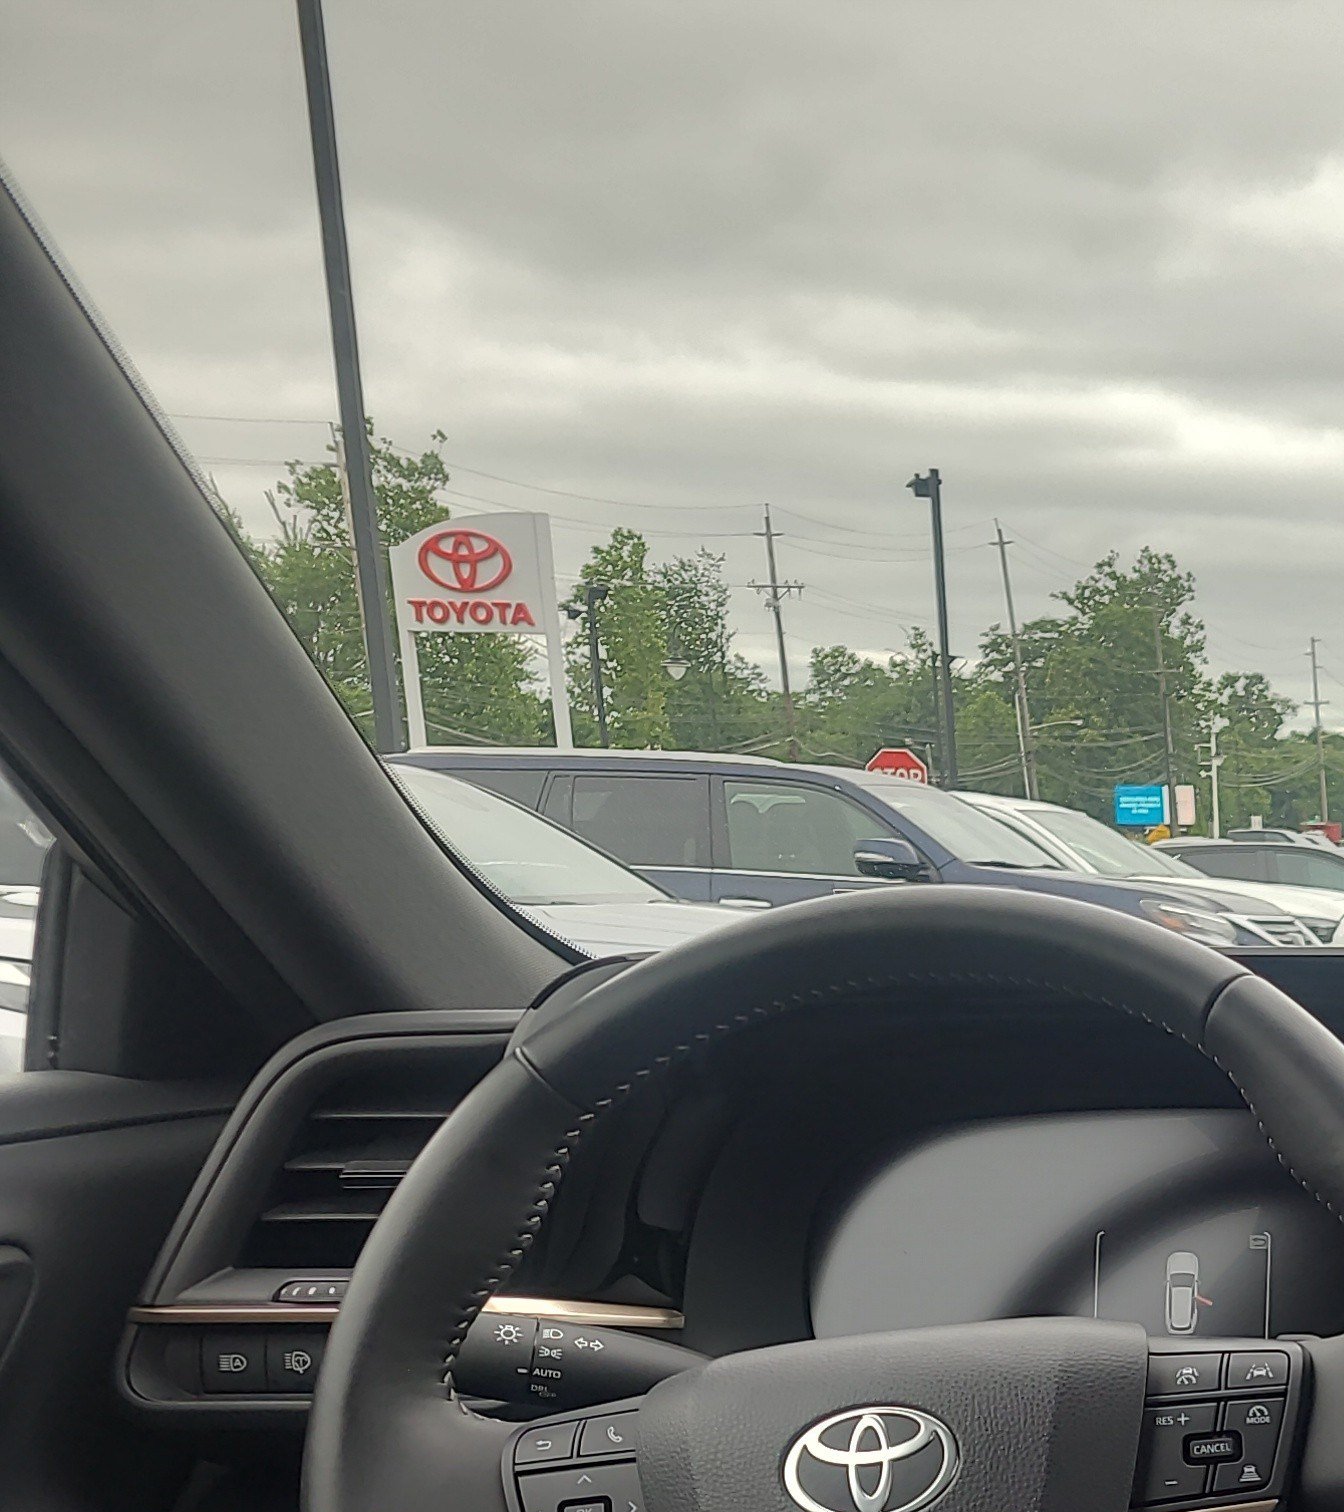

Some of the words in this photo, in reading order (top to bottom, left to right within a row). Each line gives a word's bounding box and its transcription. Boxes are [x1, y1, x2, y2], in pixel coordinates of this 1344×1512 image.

[407, 599, 535, 626] TOYOTA
[532, 1367, 562, 1379] AUTO
[1155, 1415, 1174, 1426] RES
[1246, 1415, 1271, 1425] MODE
[1193, 1442, 1231, 1455] CANCEL
